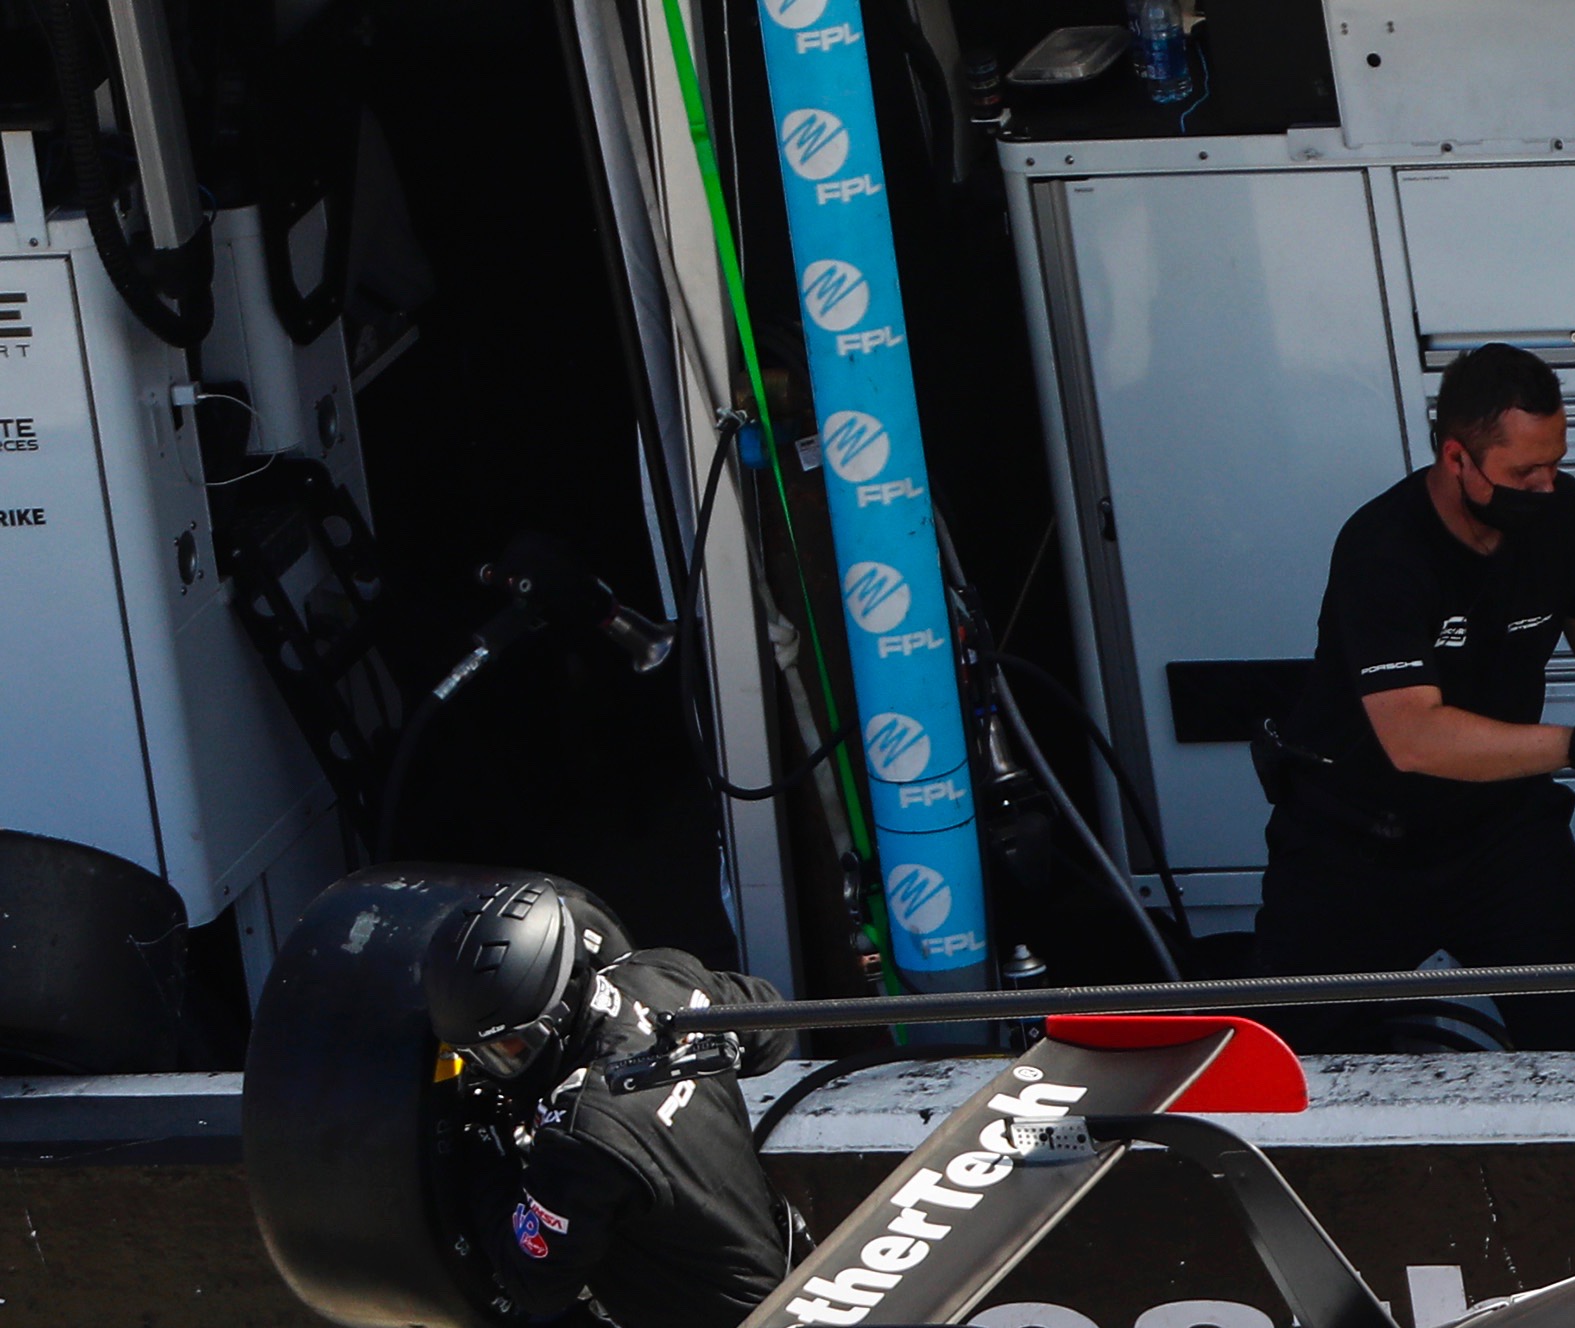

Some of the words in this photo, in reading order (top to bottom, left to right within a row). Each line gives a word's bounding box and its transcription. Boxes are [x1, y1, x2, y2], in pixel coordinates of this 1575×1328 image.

[796, 24, 860, 54] FPL
[816, 175, 882, 204] FPL
[836, 326, 903, 356] FPL
[857, 477, 924, 508] FPL
[878, 628, 945, 659] FPL
[1361, 659, 1424, 676] PORSCHE
[898, 780, 967, 808] FPL
[922, 932, 986, 958] FPL
